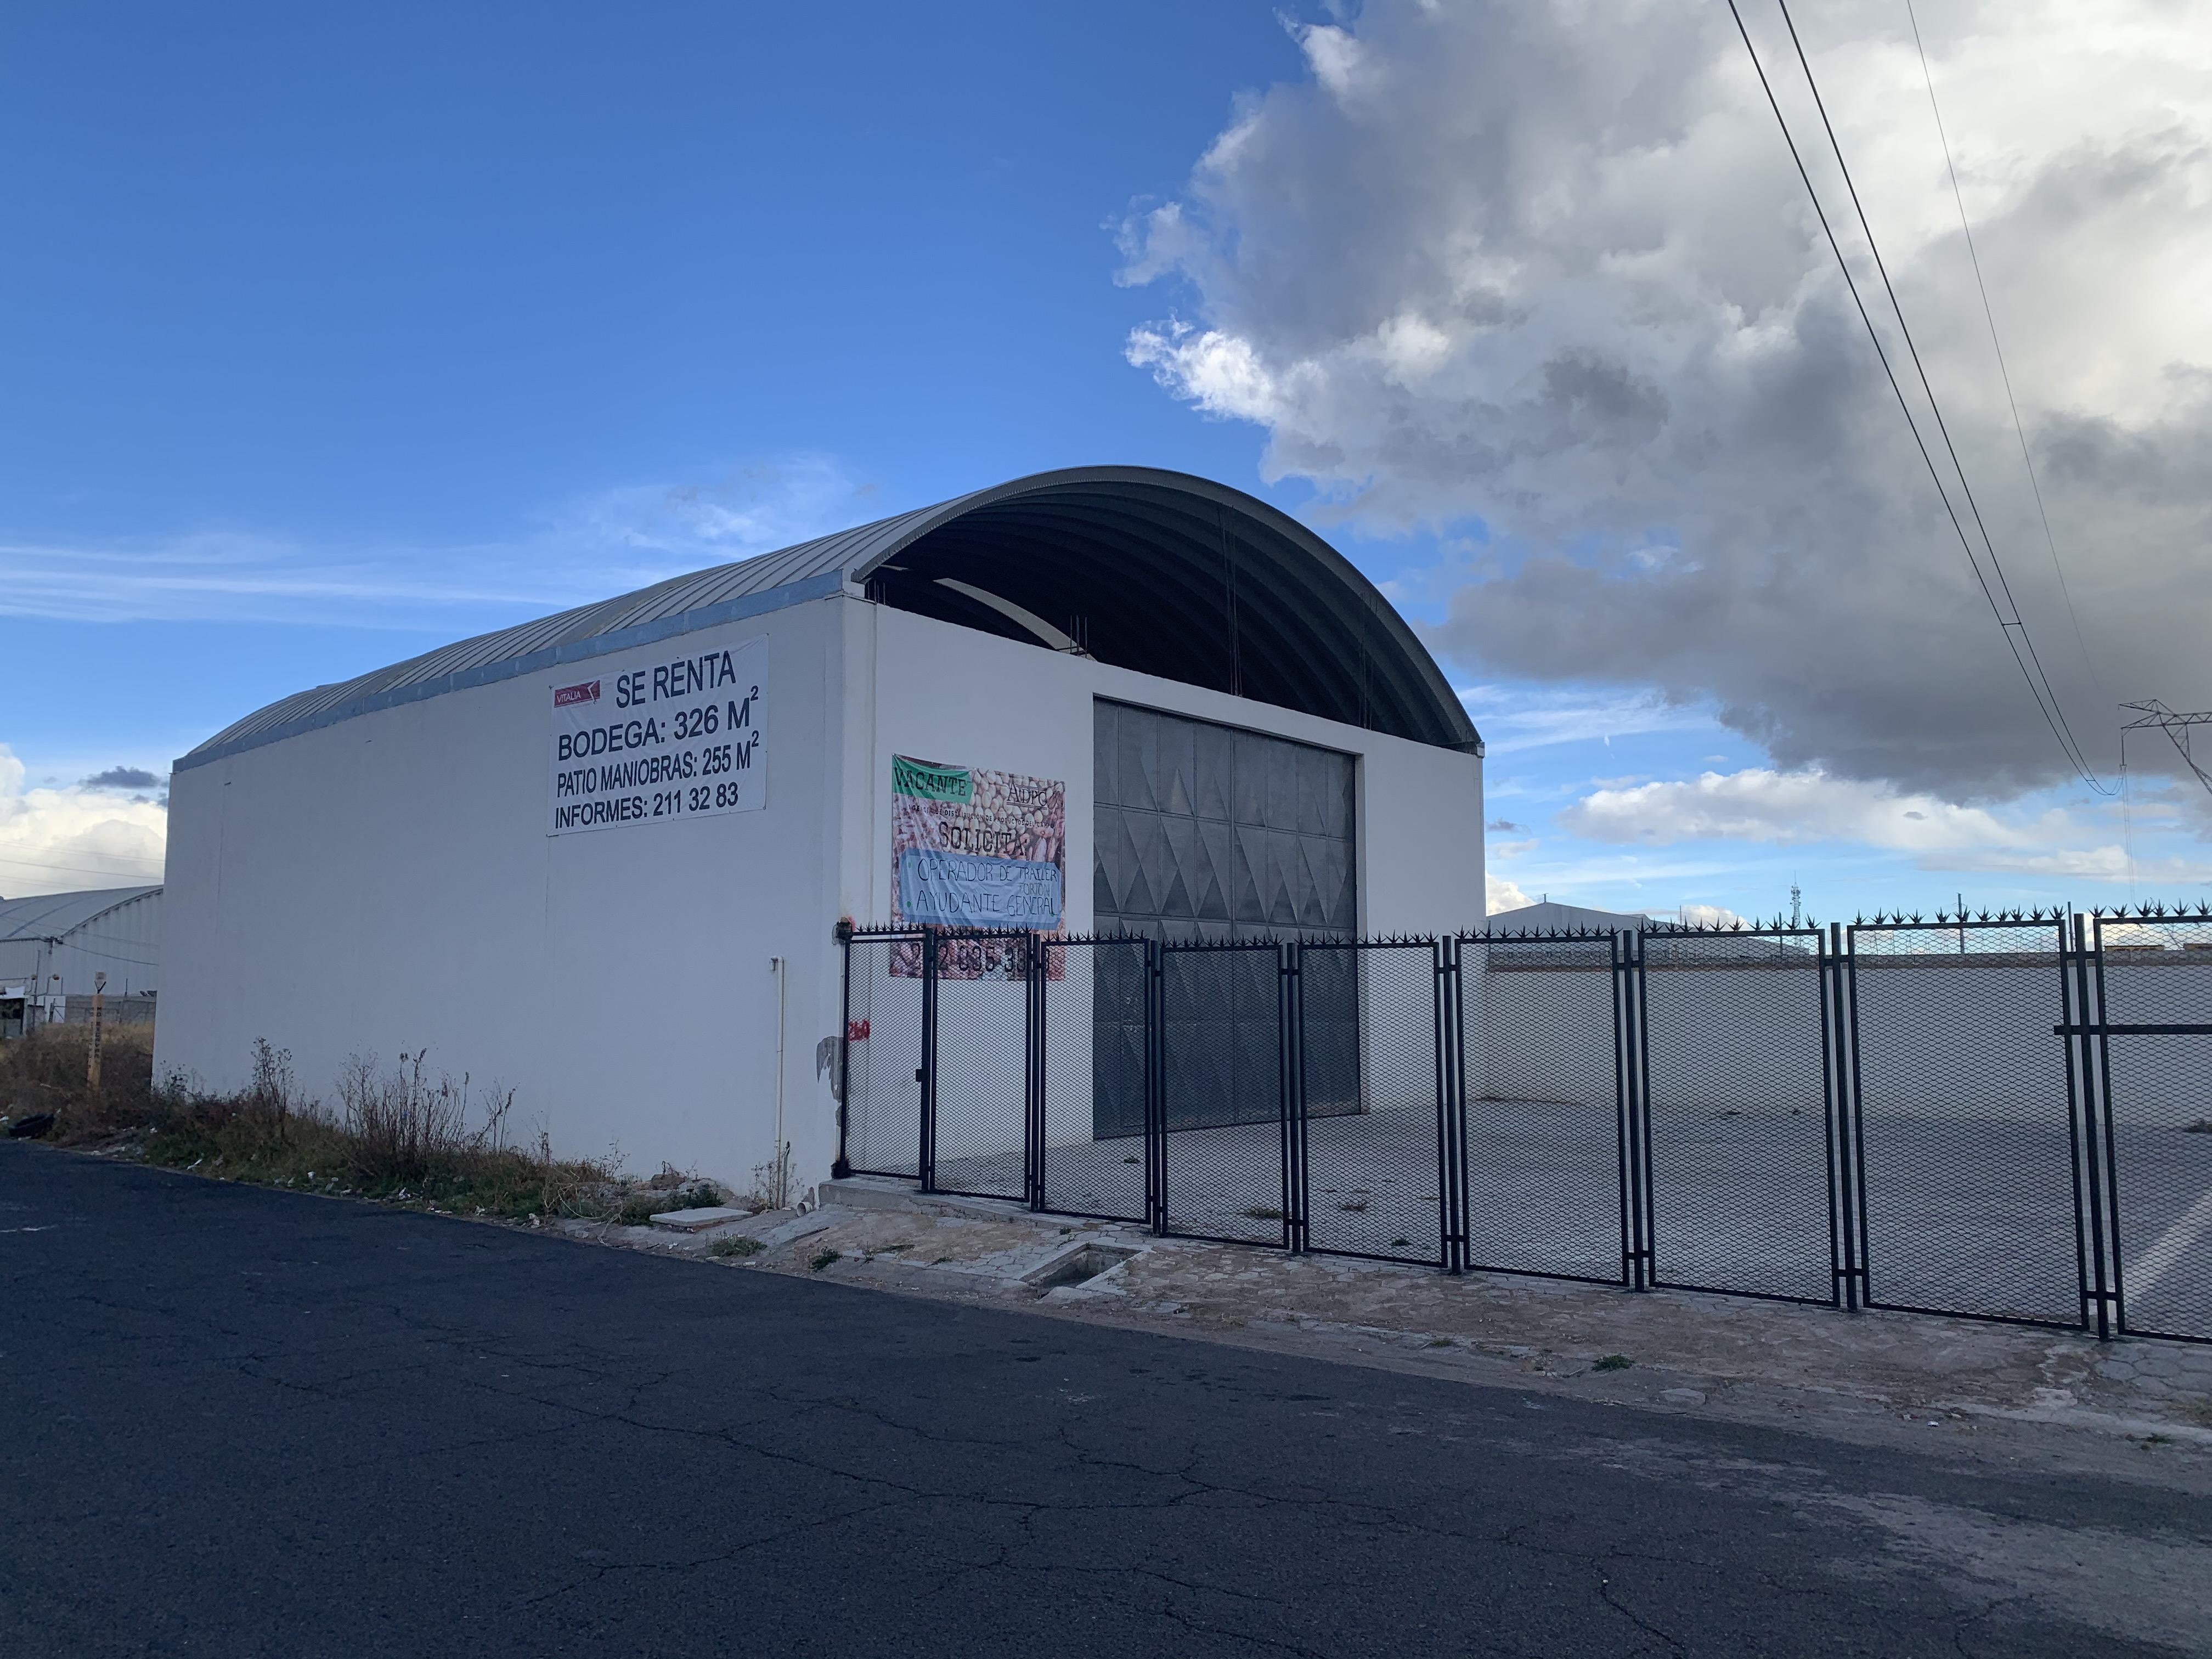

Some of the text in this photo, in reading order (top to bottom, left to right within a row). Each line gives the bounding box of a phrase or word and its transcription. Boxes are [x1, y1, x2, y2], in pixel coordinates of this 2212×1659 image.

[616, 650, 736, 708] SE RENTA
[556, 690, 582, 703] VITALIA
[558, 717, 665, 761] BODEGA:
[674, 705, 719, 740] 326
[557, 768, 597, 798] PATIO
[601, 751, 697, 792] MANIOBRAS:
[702, 744, 731, 776] 255
[894, 766, 967, 797] VACANTE
[555, 782, 738, 829] INFORMES: 211 32 83
[945, 810, 984, 820] DISTIBUCIÓN
[918, 858, 1058, 882] OPERADOR DE TRAILER
[916, 890, 1059, 917] AYUDANTE GENERAL
